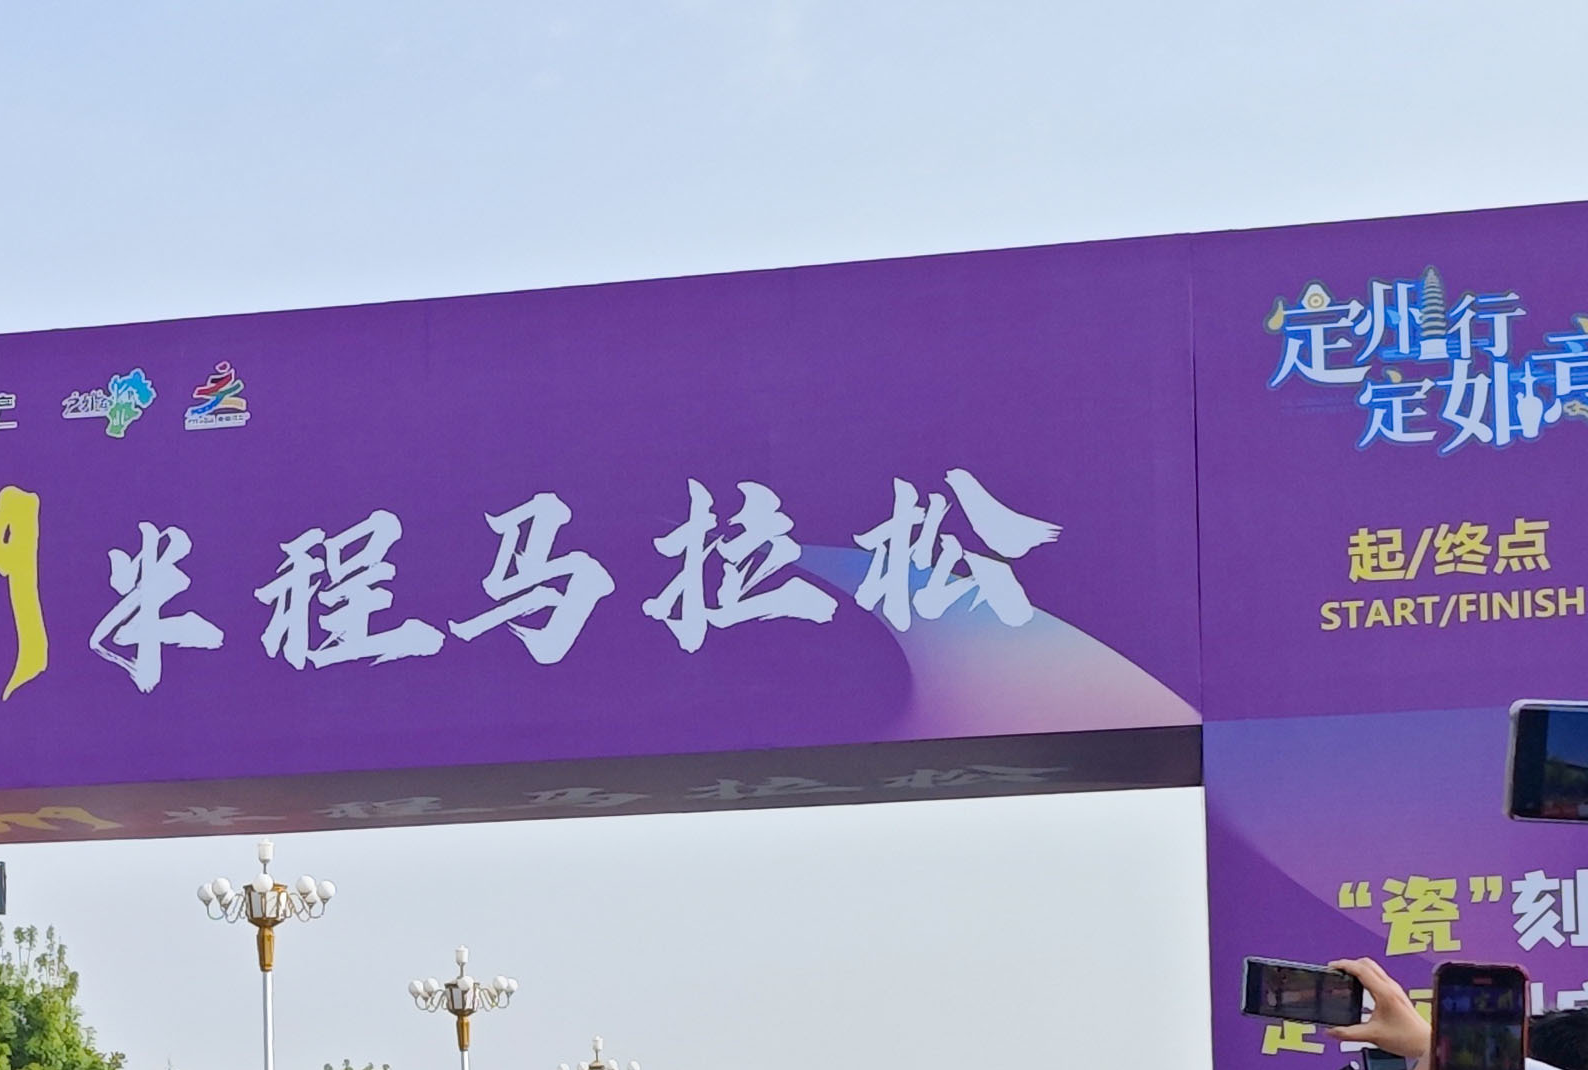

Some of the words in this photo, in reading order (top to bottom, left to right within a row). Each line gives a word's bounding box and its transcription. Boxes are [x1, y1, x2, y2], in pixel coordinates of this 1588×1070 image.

[1348, 518, 1551, 583] 起/终点
[1320, 586, 1586, 631] START/FINISH
